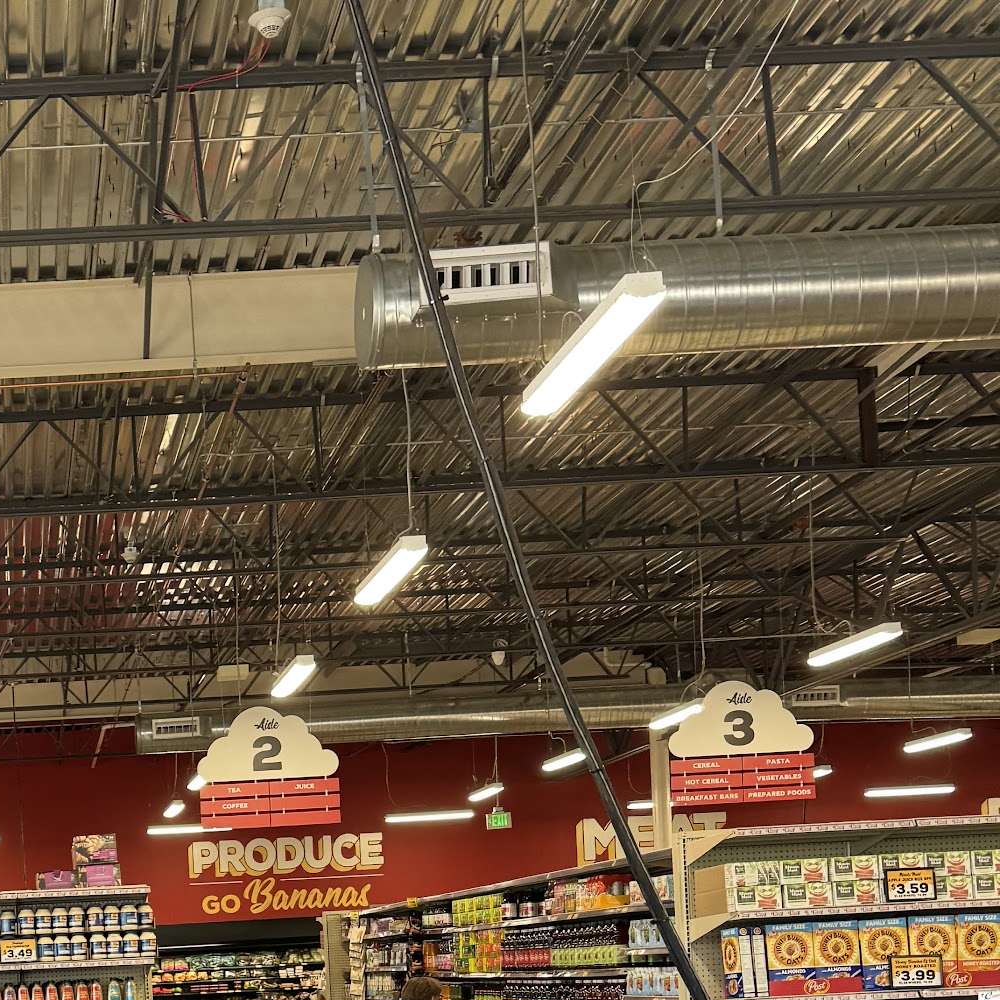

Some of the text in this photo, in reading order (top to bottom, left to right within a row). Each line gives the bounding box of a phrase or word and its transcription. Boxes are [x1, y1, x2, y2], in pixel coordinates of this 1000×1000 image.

[723, 709, 755, 746] 3
[252, 735, 283, 771] 2
[692, 761, 720, 769] CEREAL
[766, 757, 791, 765] PASTA
[685, 777, 729, 786] HOT CEREAL
[756, 773, 802, 782] VEGETABLES
[227, 786, 242, 794] TEA
[294, 782, 315, 790] JUICE
[676, 792, 739, 802] BREAKFAST BARS
[747, 788, 812, 799] PREPARED FOODS
[222, 802, 248, 810] COFFEE
[188, 832, 385, 879] PRODUCE
[891, 882, 929, 895] $3.59
[202, 877, 372, 915] GO Bananas
[869, 930, 900, 950] HONEY BUNCHES
[918, 926, 948, 946] HONEY BUNCHES
[966, 925, 996, 945] HONEY BUNCHES
[776, 935, 806, 954] HONEY BUNCHES
[822, 933, 852, 952] HONEY BUNCHES
[975, 946, 993, 956] OATS
[786, 955, 804, 965] OATS
[832, 953, 850, 963] OATS
[895, 969, 936, 981] $3.99
[950, 974, 968, 986] Post
[808, 978, 826, 993] Post
